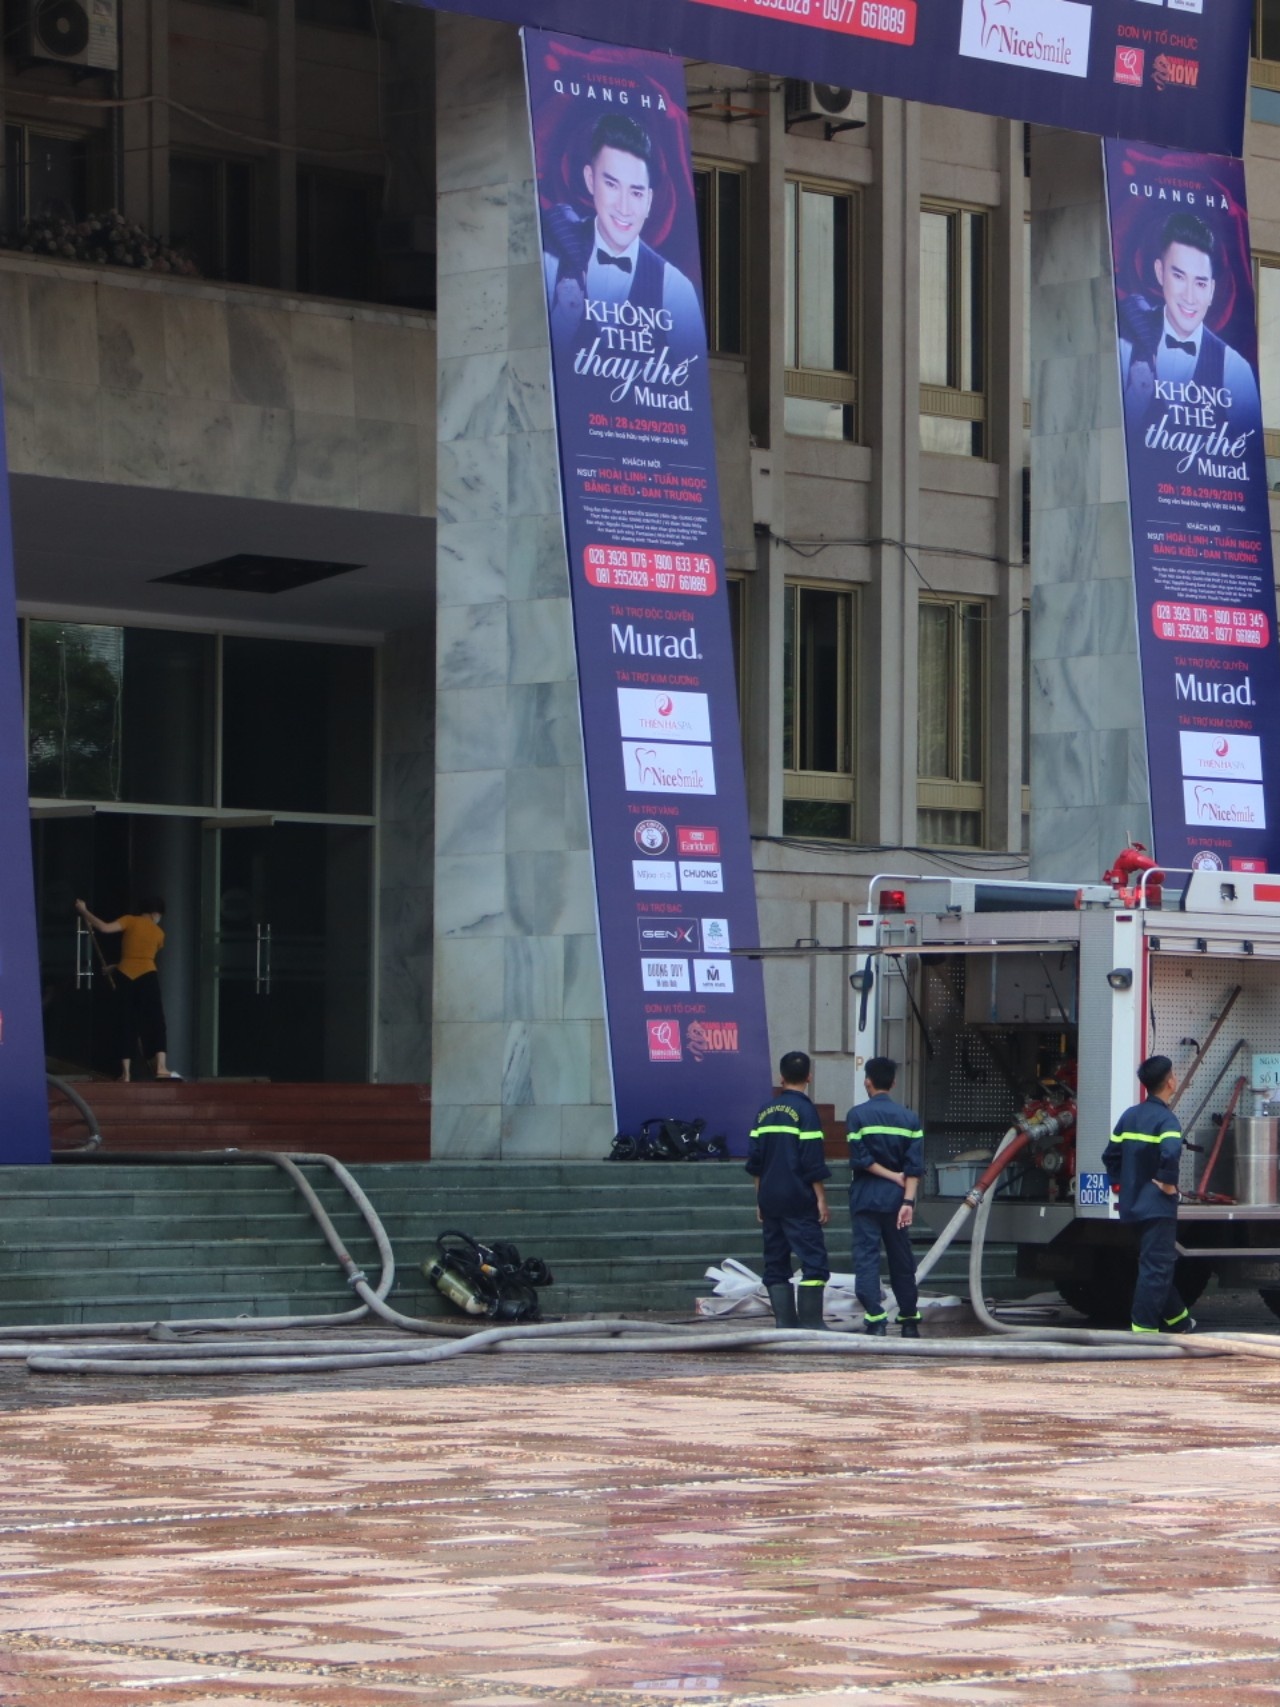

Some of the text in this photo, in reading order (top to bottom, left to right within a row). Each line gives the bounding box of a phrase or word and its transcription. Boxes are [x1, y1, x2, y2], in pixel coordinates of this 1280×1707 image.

[861, 2, 905, 33] 661889
[998, 24, 1072, 65] NiceSmile
[554, 80, 667, 110] QUANG HÀ
[1130, 182, 1229, 210] QUANG HÀ
[584, 299, 674, 331] KHÔNG
[601, 324, 655, 354] THỂ
[574, 337, 698, 403] thay thế
[1154, 380, 1232, 408] KHÔNG
[588, 414, 608, 426] 20h
[1168, 401, 1216, 428] THỂ
[1145, 414, 1255, 474] thay thế
[1158, 484, 1174, 494] 20h
[588, 548, 604, 564] 028
[607, 550, 628, 566] 3929
[654, 554, 673, 571] 1900
[676, 556, 691, 572] 633
[694, 558, 710, 574] 345
[596, 568, 610, 584] 081
[656, 572, 676, 590] 0977
[1156, 604, 1170, 620] 028
[1173, 606, 1190, 622] 3929
[1214, 610, 1230, 625] 1900
[1233, 612, 1246, 626] 633
[1250, 613, 1264, 628] 345
[1215, 627, 1232, 642] 0977
[652, 766, 704, 788] NiceSmile
[1208, 802, 1256, 822] NiceSmile
[1086, 1174, 1104, 1189] 29A
